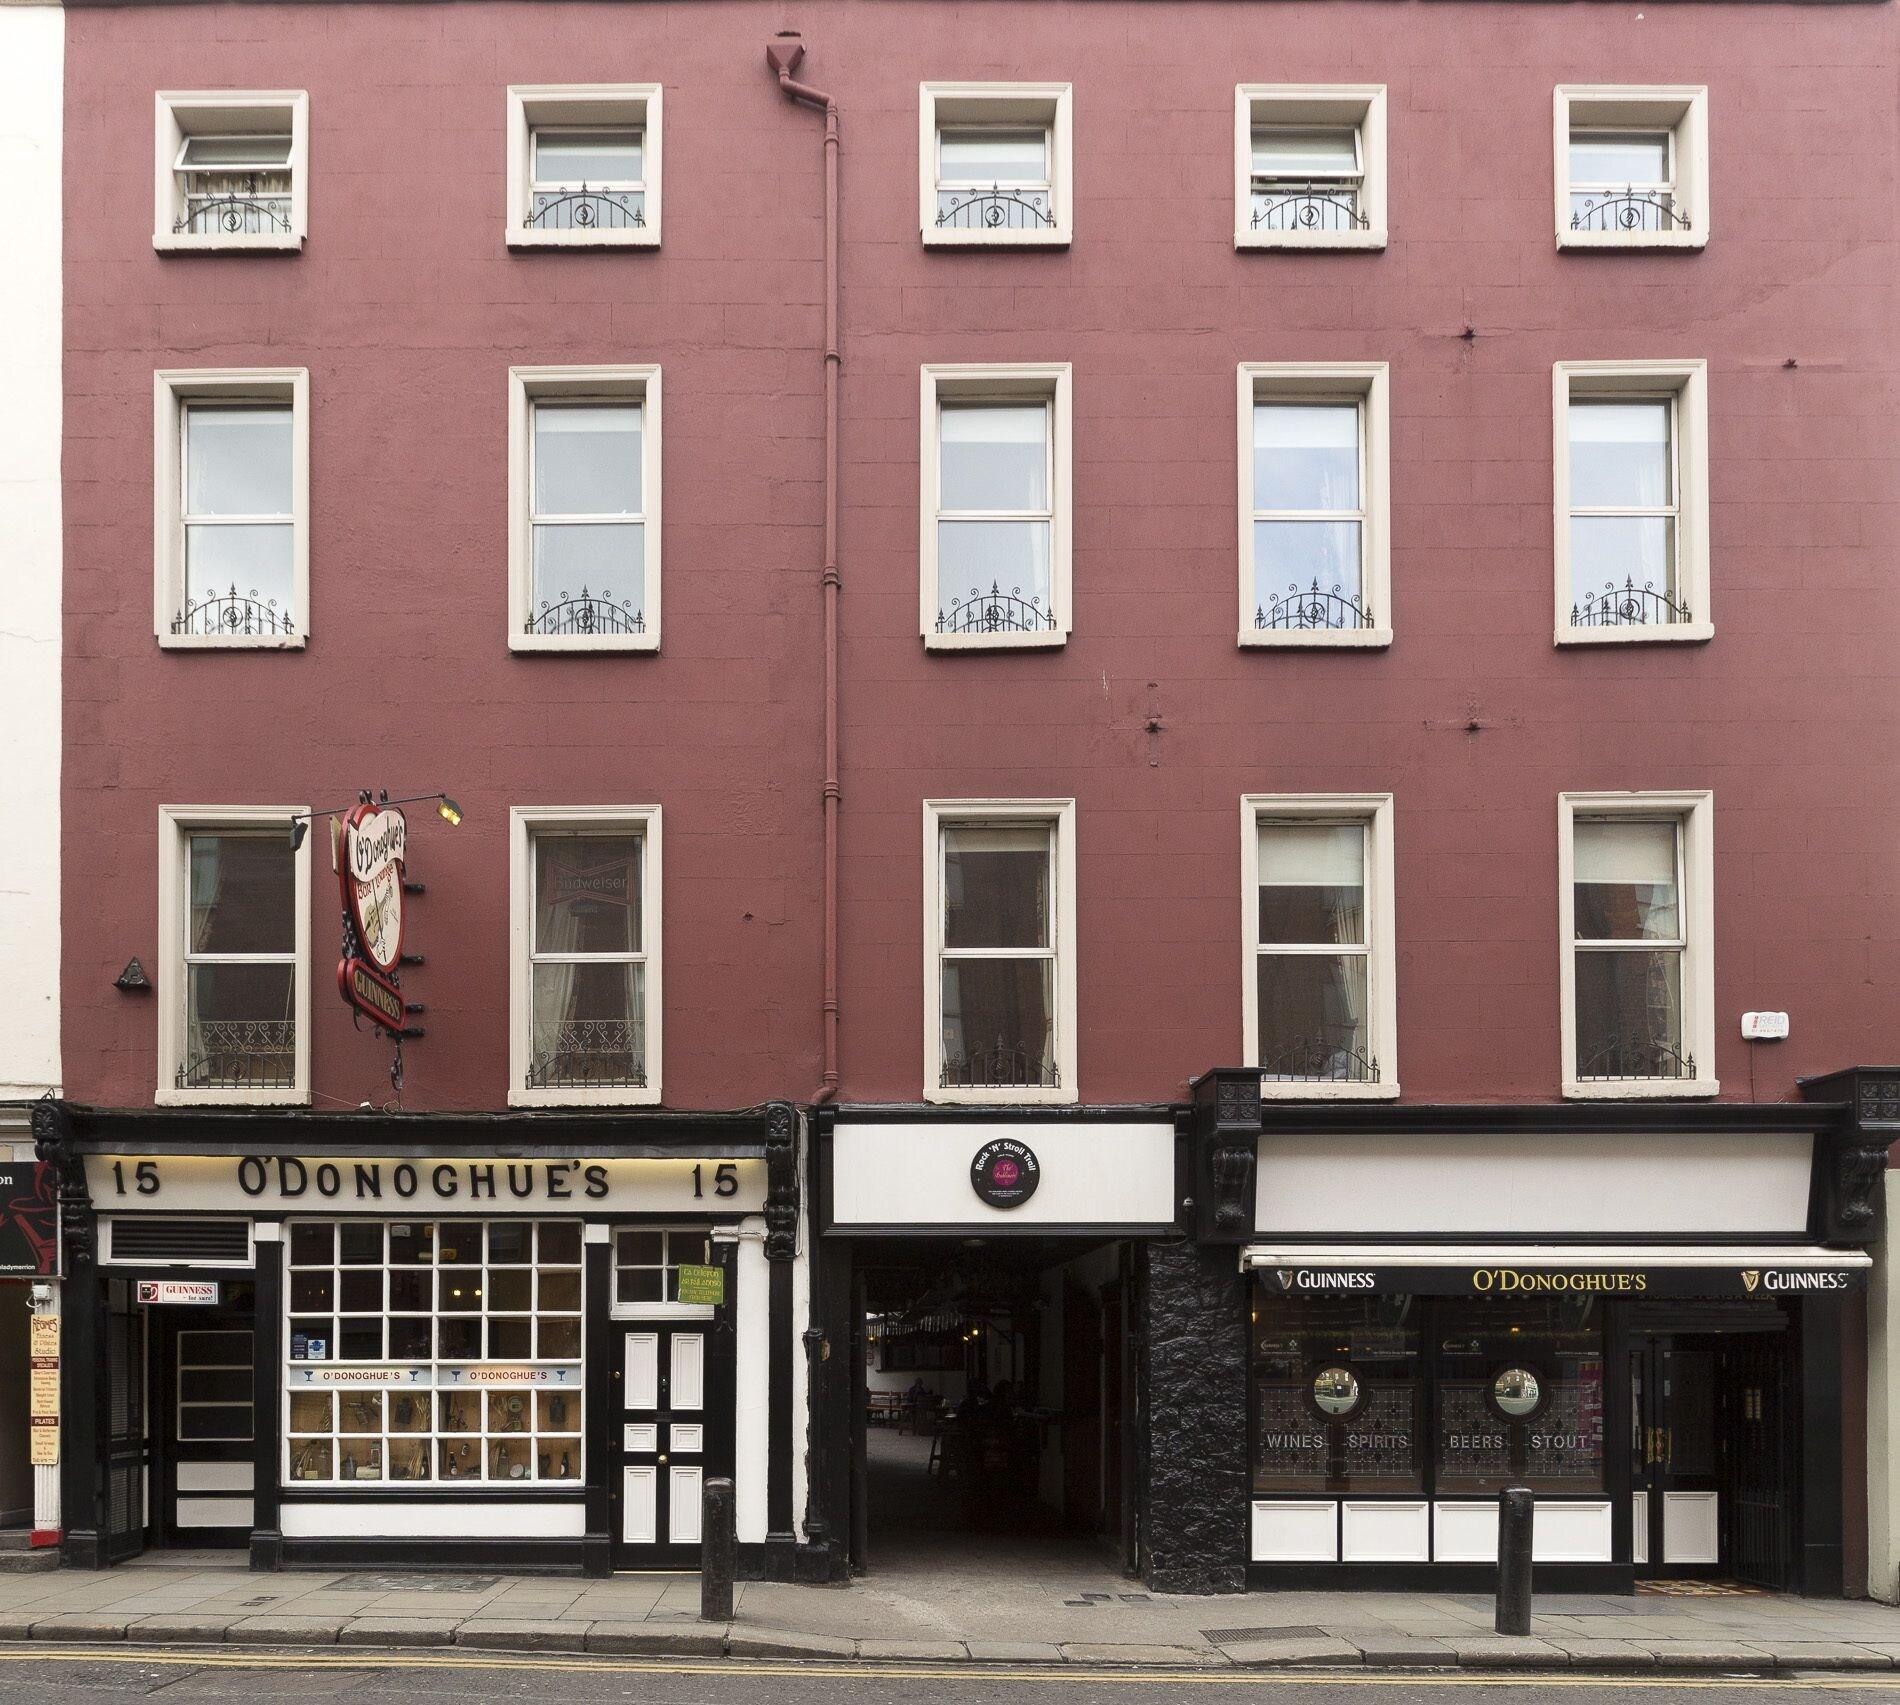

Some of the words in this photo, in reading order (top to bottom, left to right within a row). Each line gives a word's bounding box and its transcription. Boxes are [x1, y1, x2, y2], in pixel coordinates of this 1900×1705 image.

[356, 815, 403, 875] O'Donoghue's
[354, 969, 401, 1020] GUINNESS
[975, 1152, 991, 1171] Rock
[1004, 1142, 1026, 1155] Stroll
[1023, 1152, 1037, 1171] Trail
[111, 1160, 161, 1195] 15
[238, 1155, 610, 1199] O'DONOGHUE'S
[692, 1163, 739, 1197] 15
[1297, 1270, 1375, 1288] GUINNESS
[1764, 1270, 1849, 1290] GUINNESS
[166, 1285, 213, 1295] GUINNESS
[323, 1371, 401, 1381] O'DONOGHUE'S
[470, 1371, 548, 1381] O'DONOGHUE'S
[1266, 1434, 1324, 1449] WINES
[1348, 1434, 1408, 1449] SPIRITS
[1450, 1435, 1503, 1449] BEERS
[1531, 1434, 1588, 1449] STOUT
